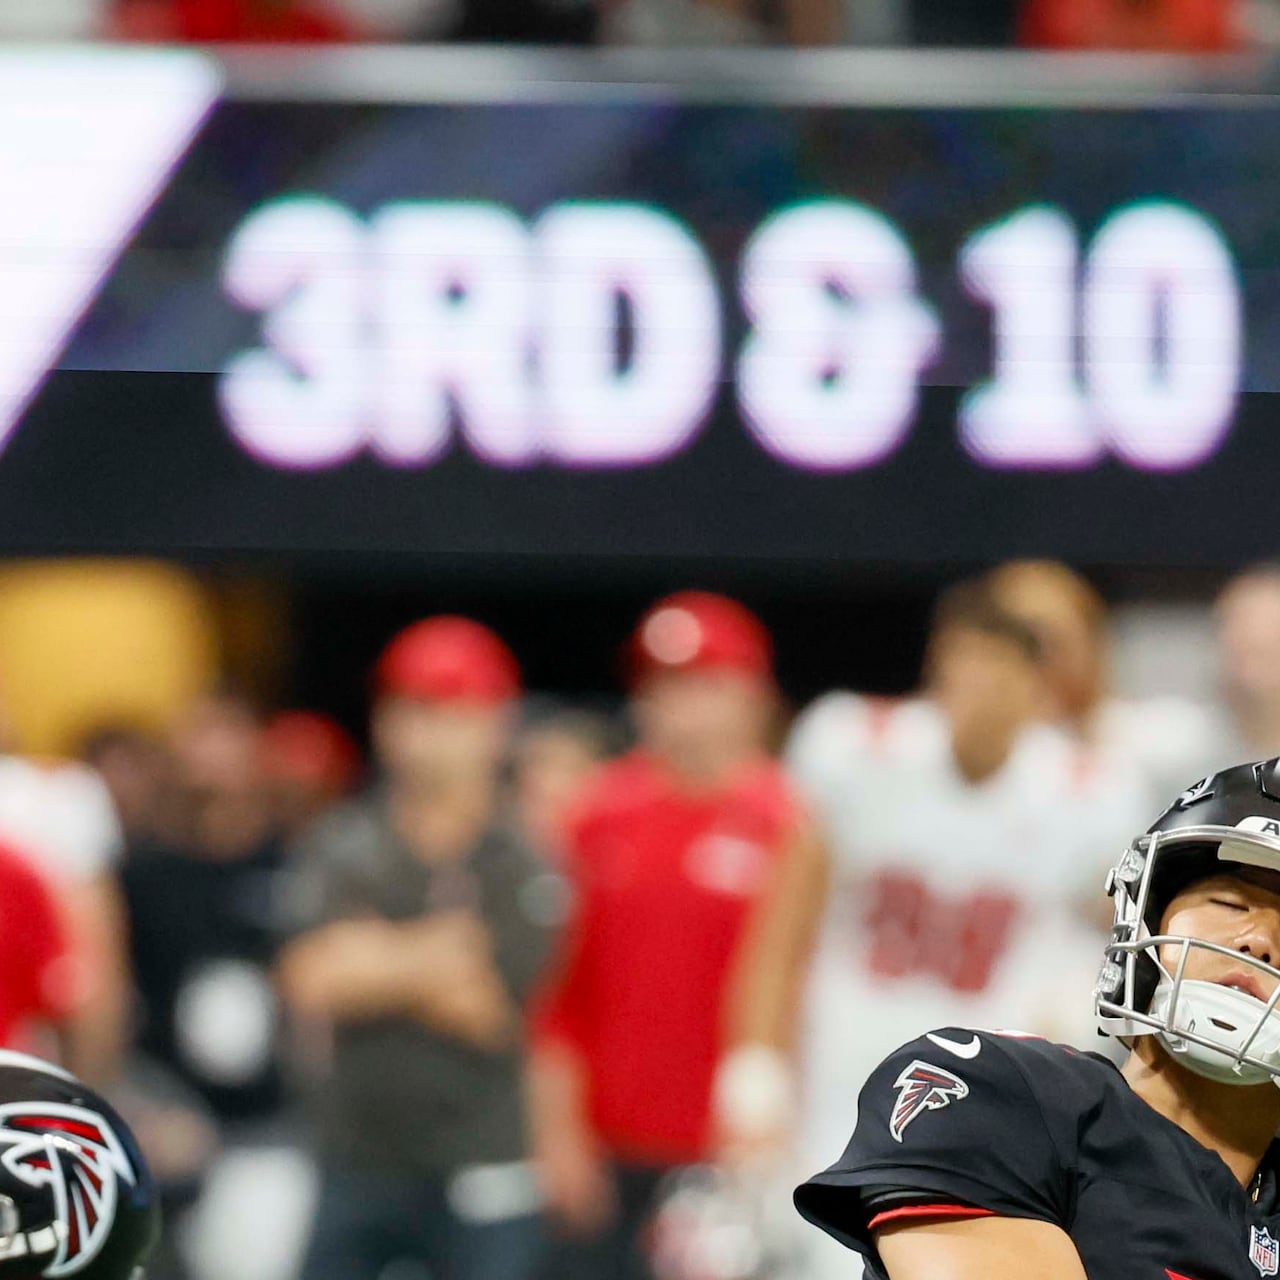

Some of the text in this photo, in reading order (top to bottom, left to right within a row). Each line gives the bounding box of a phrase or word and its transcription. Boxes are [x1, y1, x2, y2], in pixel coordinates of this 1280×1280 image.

[218, 194, 1246, 474] 3RD & 10
